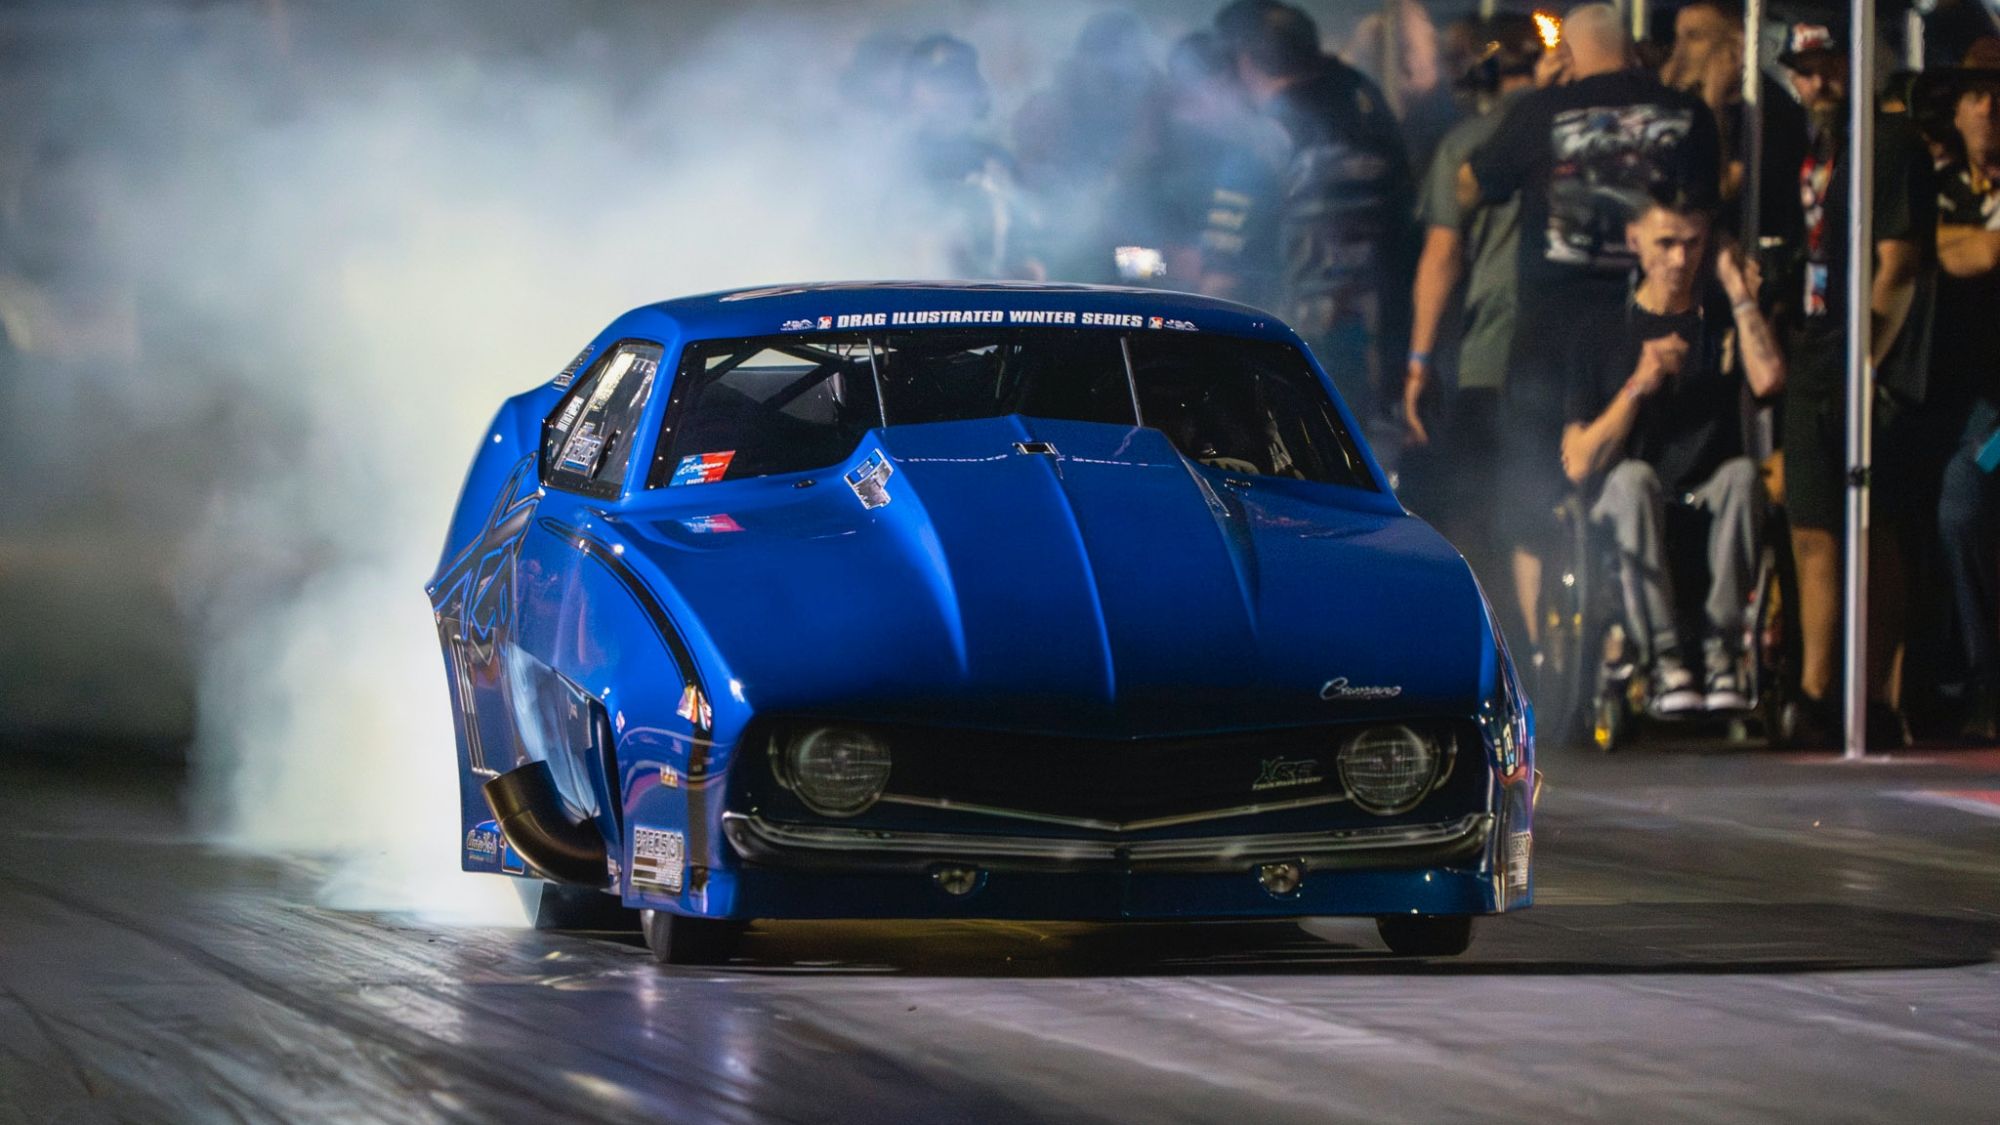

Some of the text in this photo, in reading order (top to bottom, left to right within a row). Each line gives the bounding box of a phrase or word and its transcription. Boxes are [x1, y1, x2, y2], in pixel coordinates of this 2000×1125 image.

[837, 310, 1143, 328] DRAG ILLUSTRATED WINTER SERIES
[1320, 677, 1402, 700] Camaro
